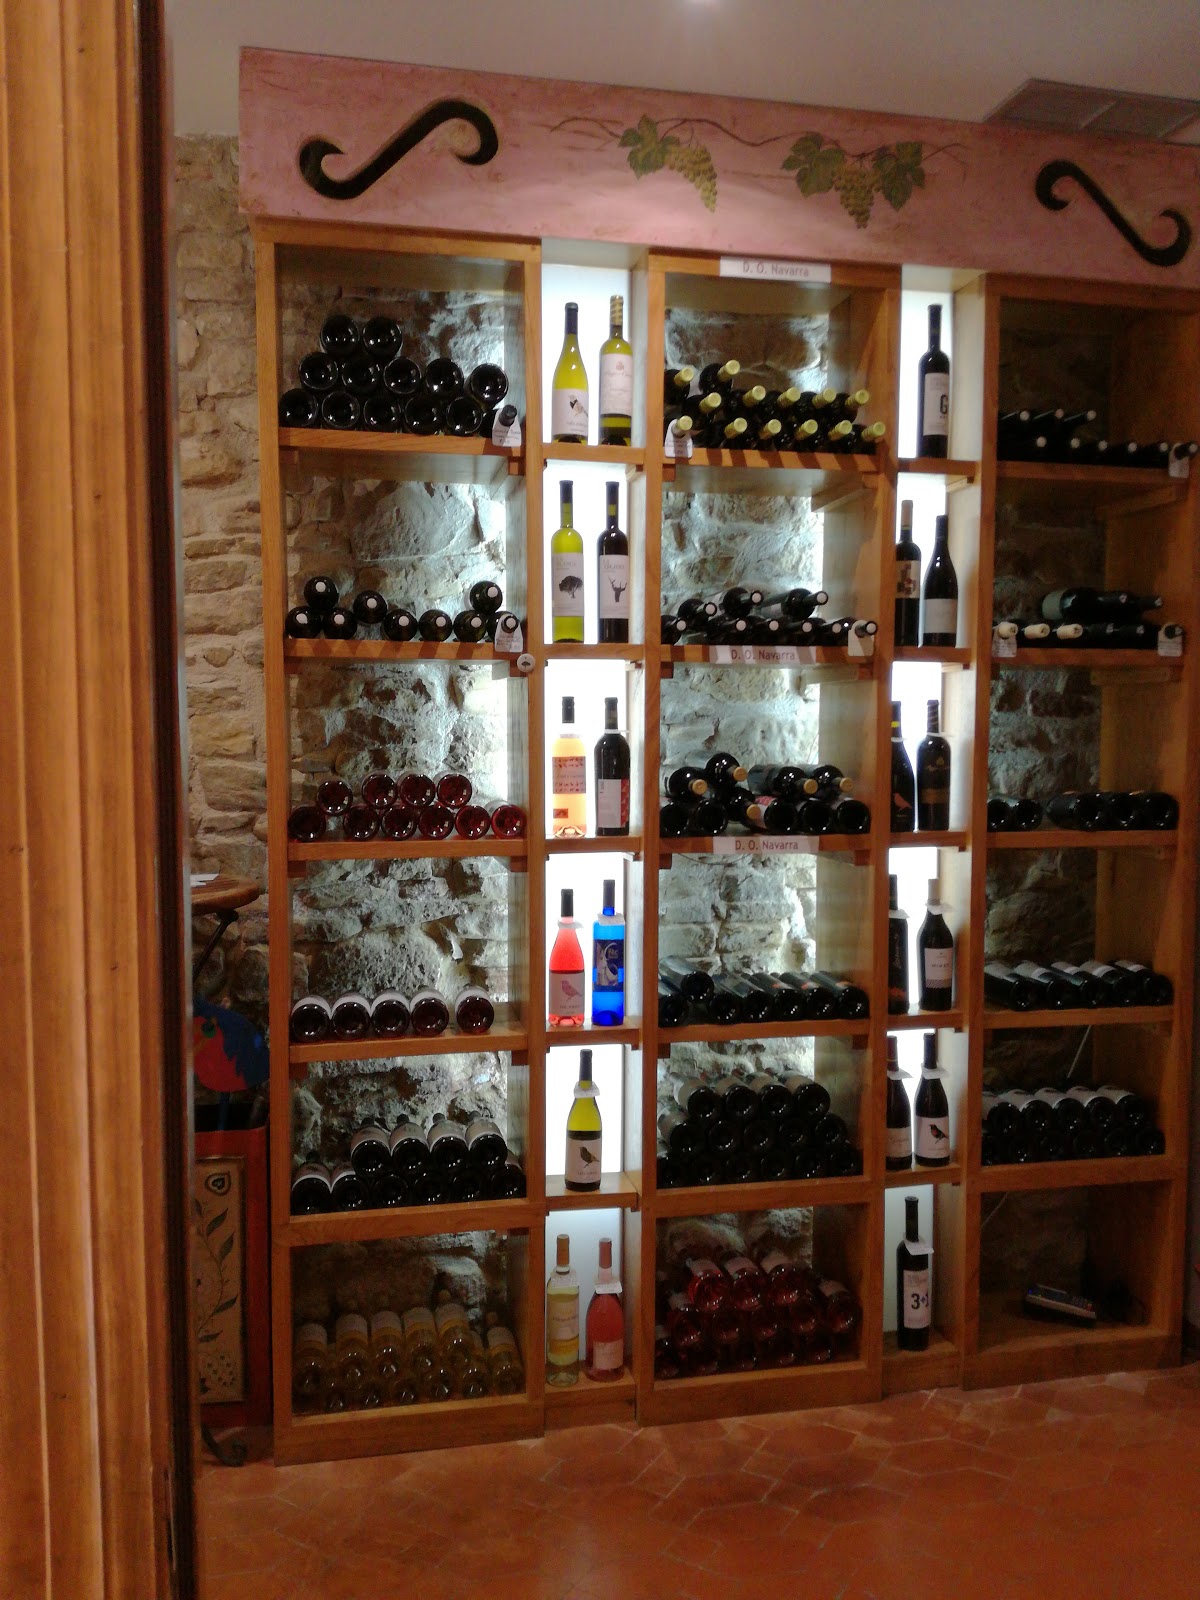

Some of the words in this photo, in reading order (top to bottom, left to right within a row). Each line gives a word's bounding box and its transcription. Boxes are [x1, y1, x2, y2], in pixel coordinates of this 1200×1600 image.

[742, 261, 753, 273] D.
[756, 262, 768, 274] O.
[771, 263, 809, 277] Navarra
[731, 649, 741, 660] D.
[744, 649, 755, 660] O.
[758, 650, 795, 660] Navarra
[735, 840, 745, 851] D.
[748, 840, 758, 851] O.
[762, 840, 799, 850] Navarra
